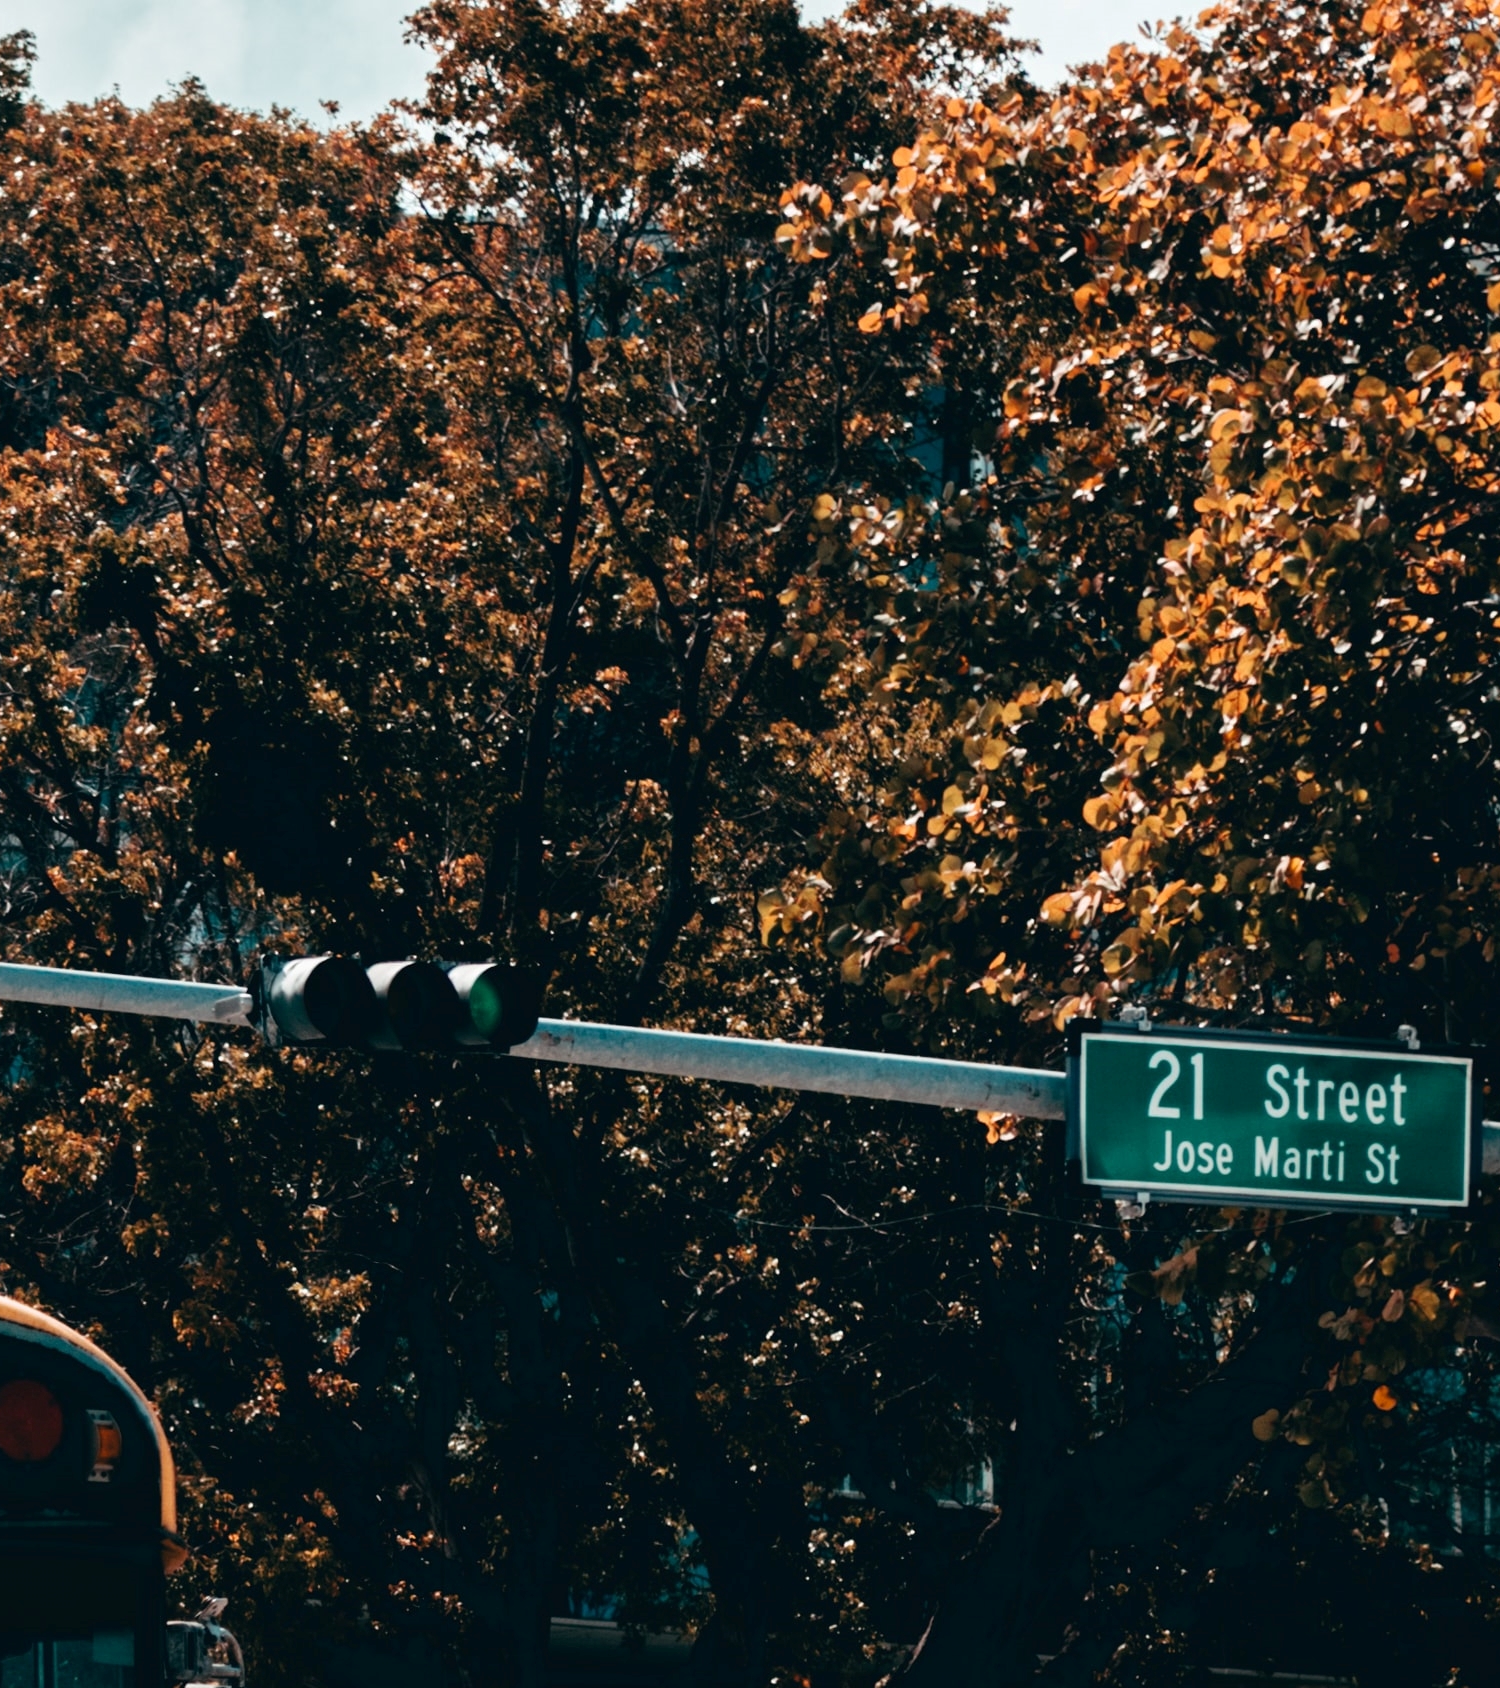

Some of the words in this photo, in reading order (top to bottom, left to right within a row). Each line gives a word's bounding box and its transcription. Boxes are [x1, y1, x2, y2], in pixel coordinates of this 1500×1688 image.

[1147, 1049, 1204, 1120] 21
[1264, 1064, 1408, 1126] Street
[1153, 1130, 1234, 1175] Jose
[1254, 1135, 1345, 1182] Marti
[1365, 1143, 1401, 1185] St
